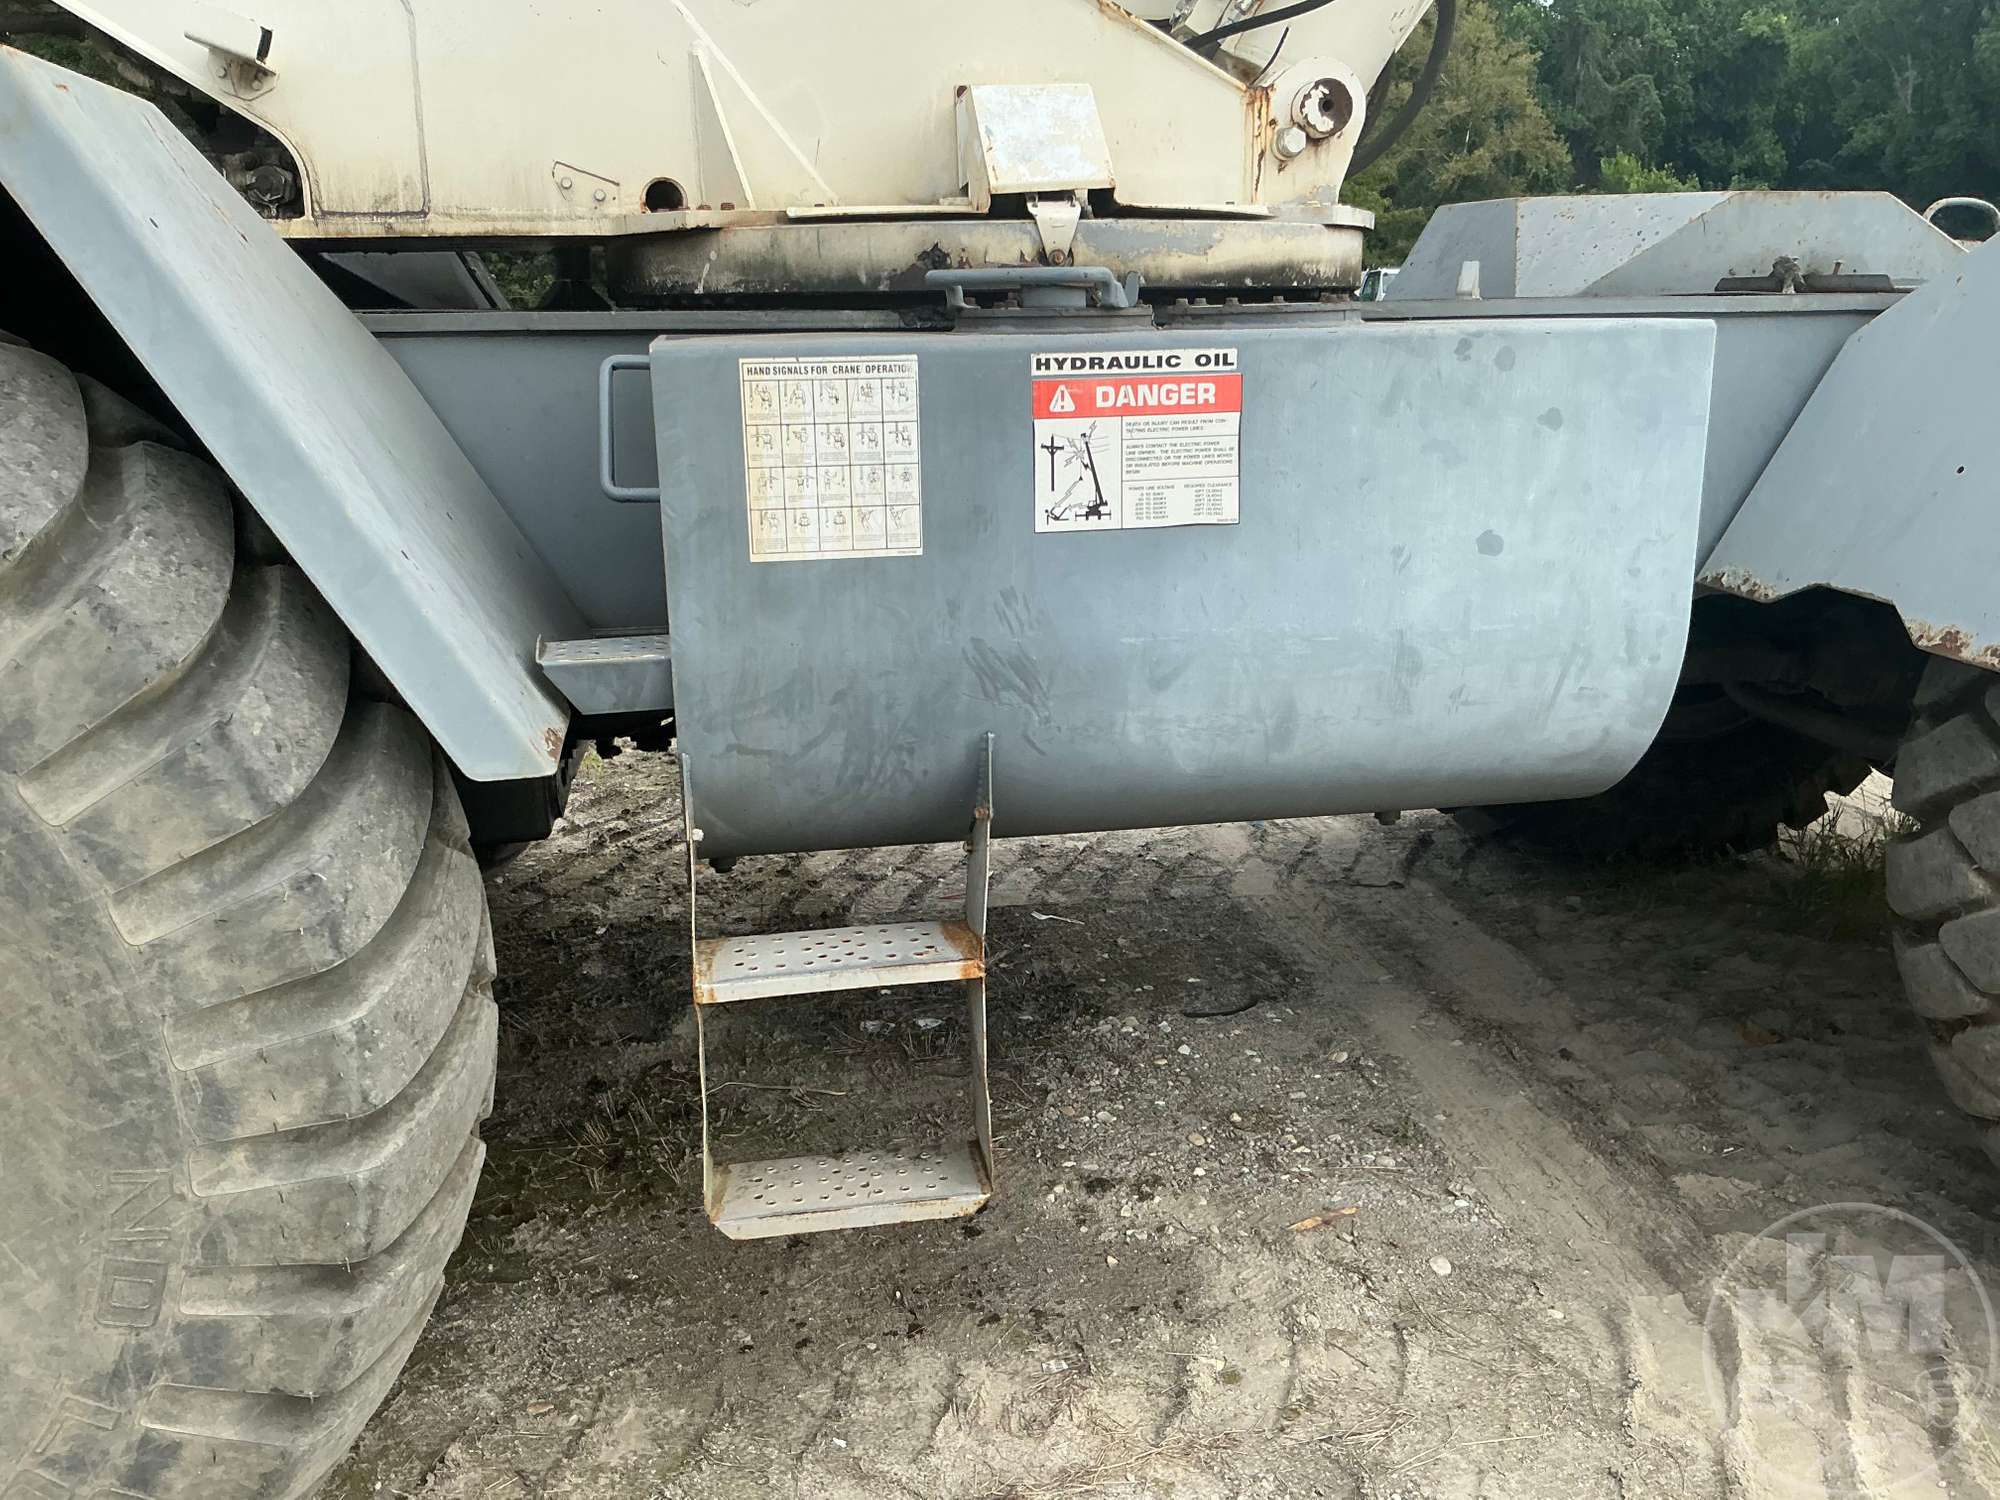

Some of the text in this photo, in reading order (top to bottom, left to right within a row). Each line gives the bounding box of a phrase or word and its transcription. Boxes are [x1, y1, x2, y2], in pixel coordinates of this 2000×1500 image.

[746, 366, 771, 376] HAND
[773, 365, 809, 376] SIGNALS
[811, 365, 828, 375] FOR
[832, 365, 861, 375] CRANE
[1035, 353, 1235, 371] HYDRAULIC OIL
[1096, 383, 1216, 409] DANGER
